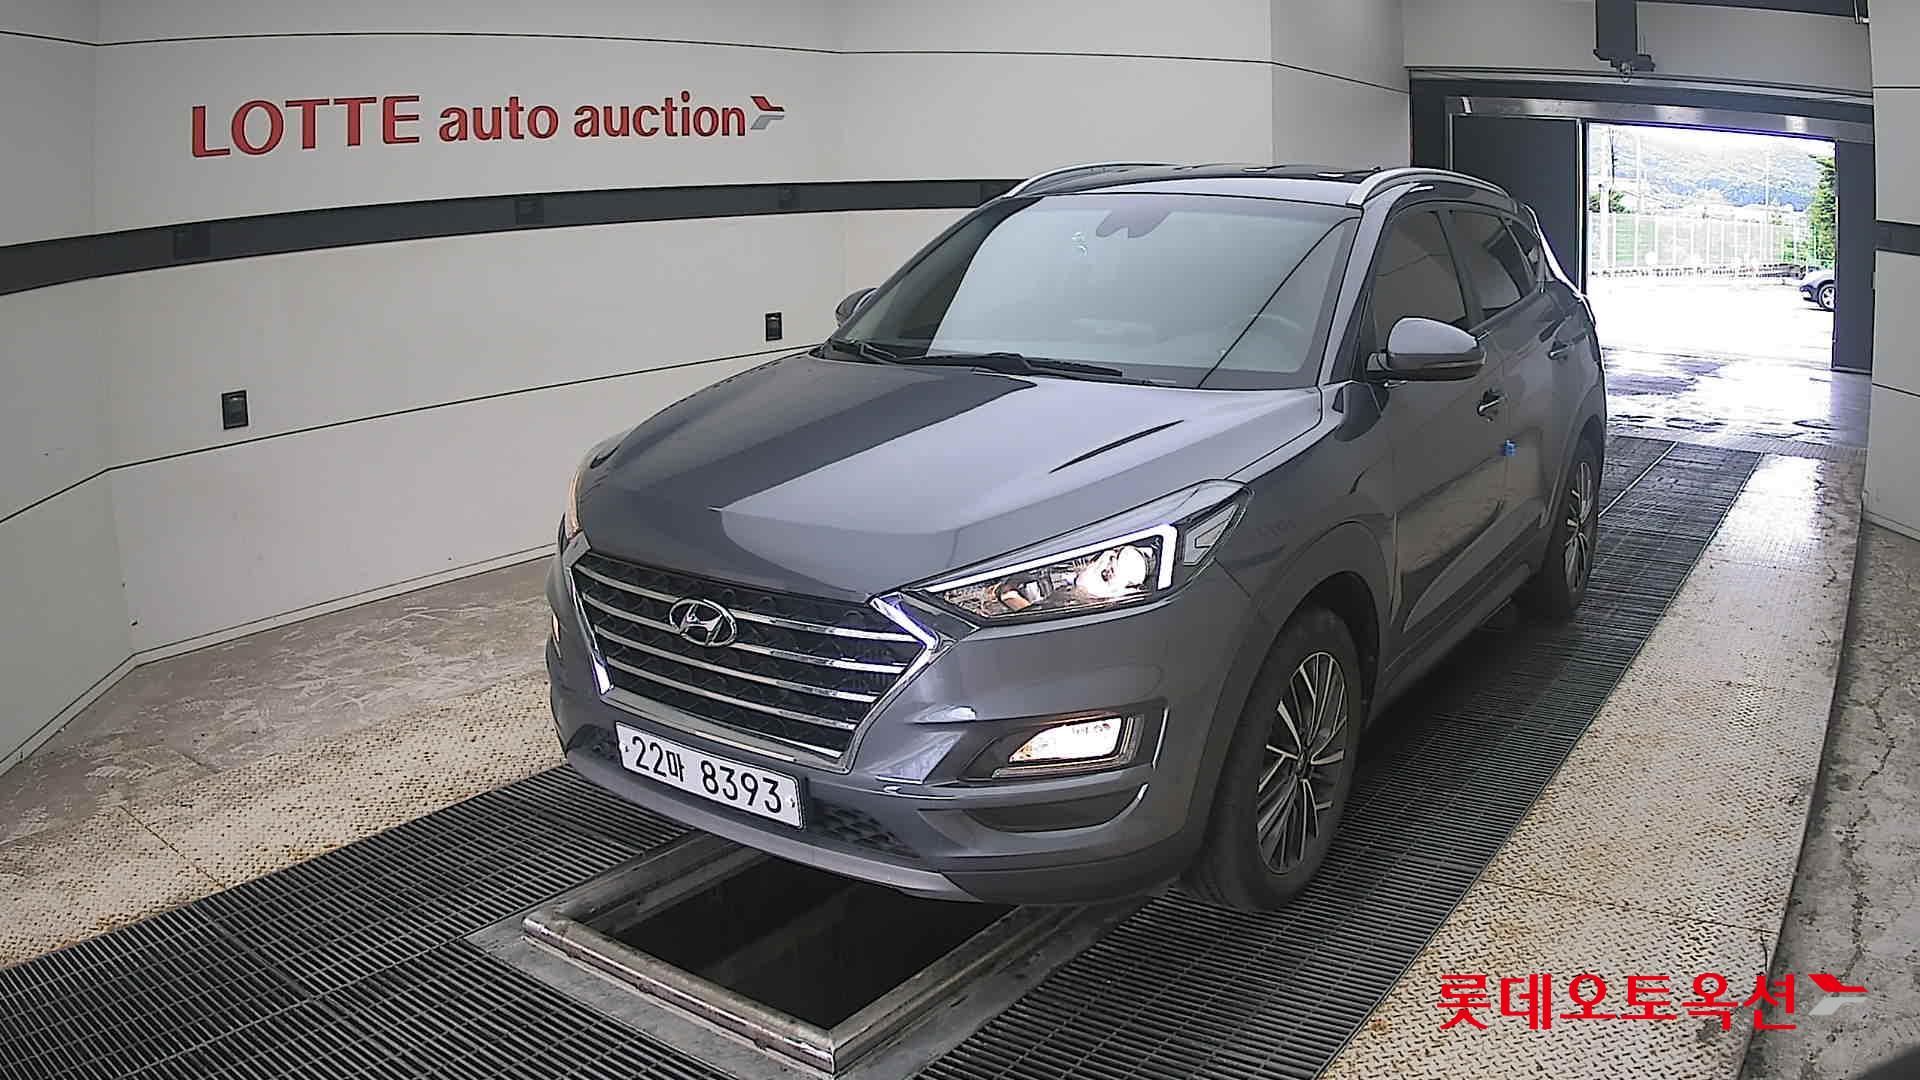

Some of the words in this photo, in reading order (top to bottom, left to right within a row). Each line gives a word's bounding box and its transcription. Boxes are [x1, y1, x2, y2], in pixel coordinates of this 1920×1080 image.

[191, 95, 420, 158] LOTTE
[438, 96, 559, 143] auto
[573, 90, 746, 138] auction
[632, 735, 685, 782] 22마
[700, 760, 782, 814] 8393
